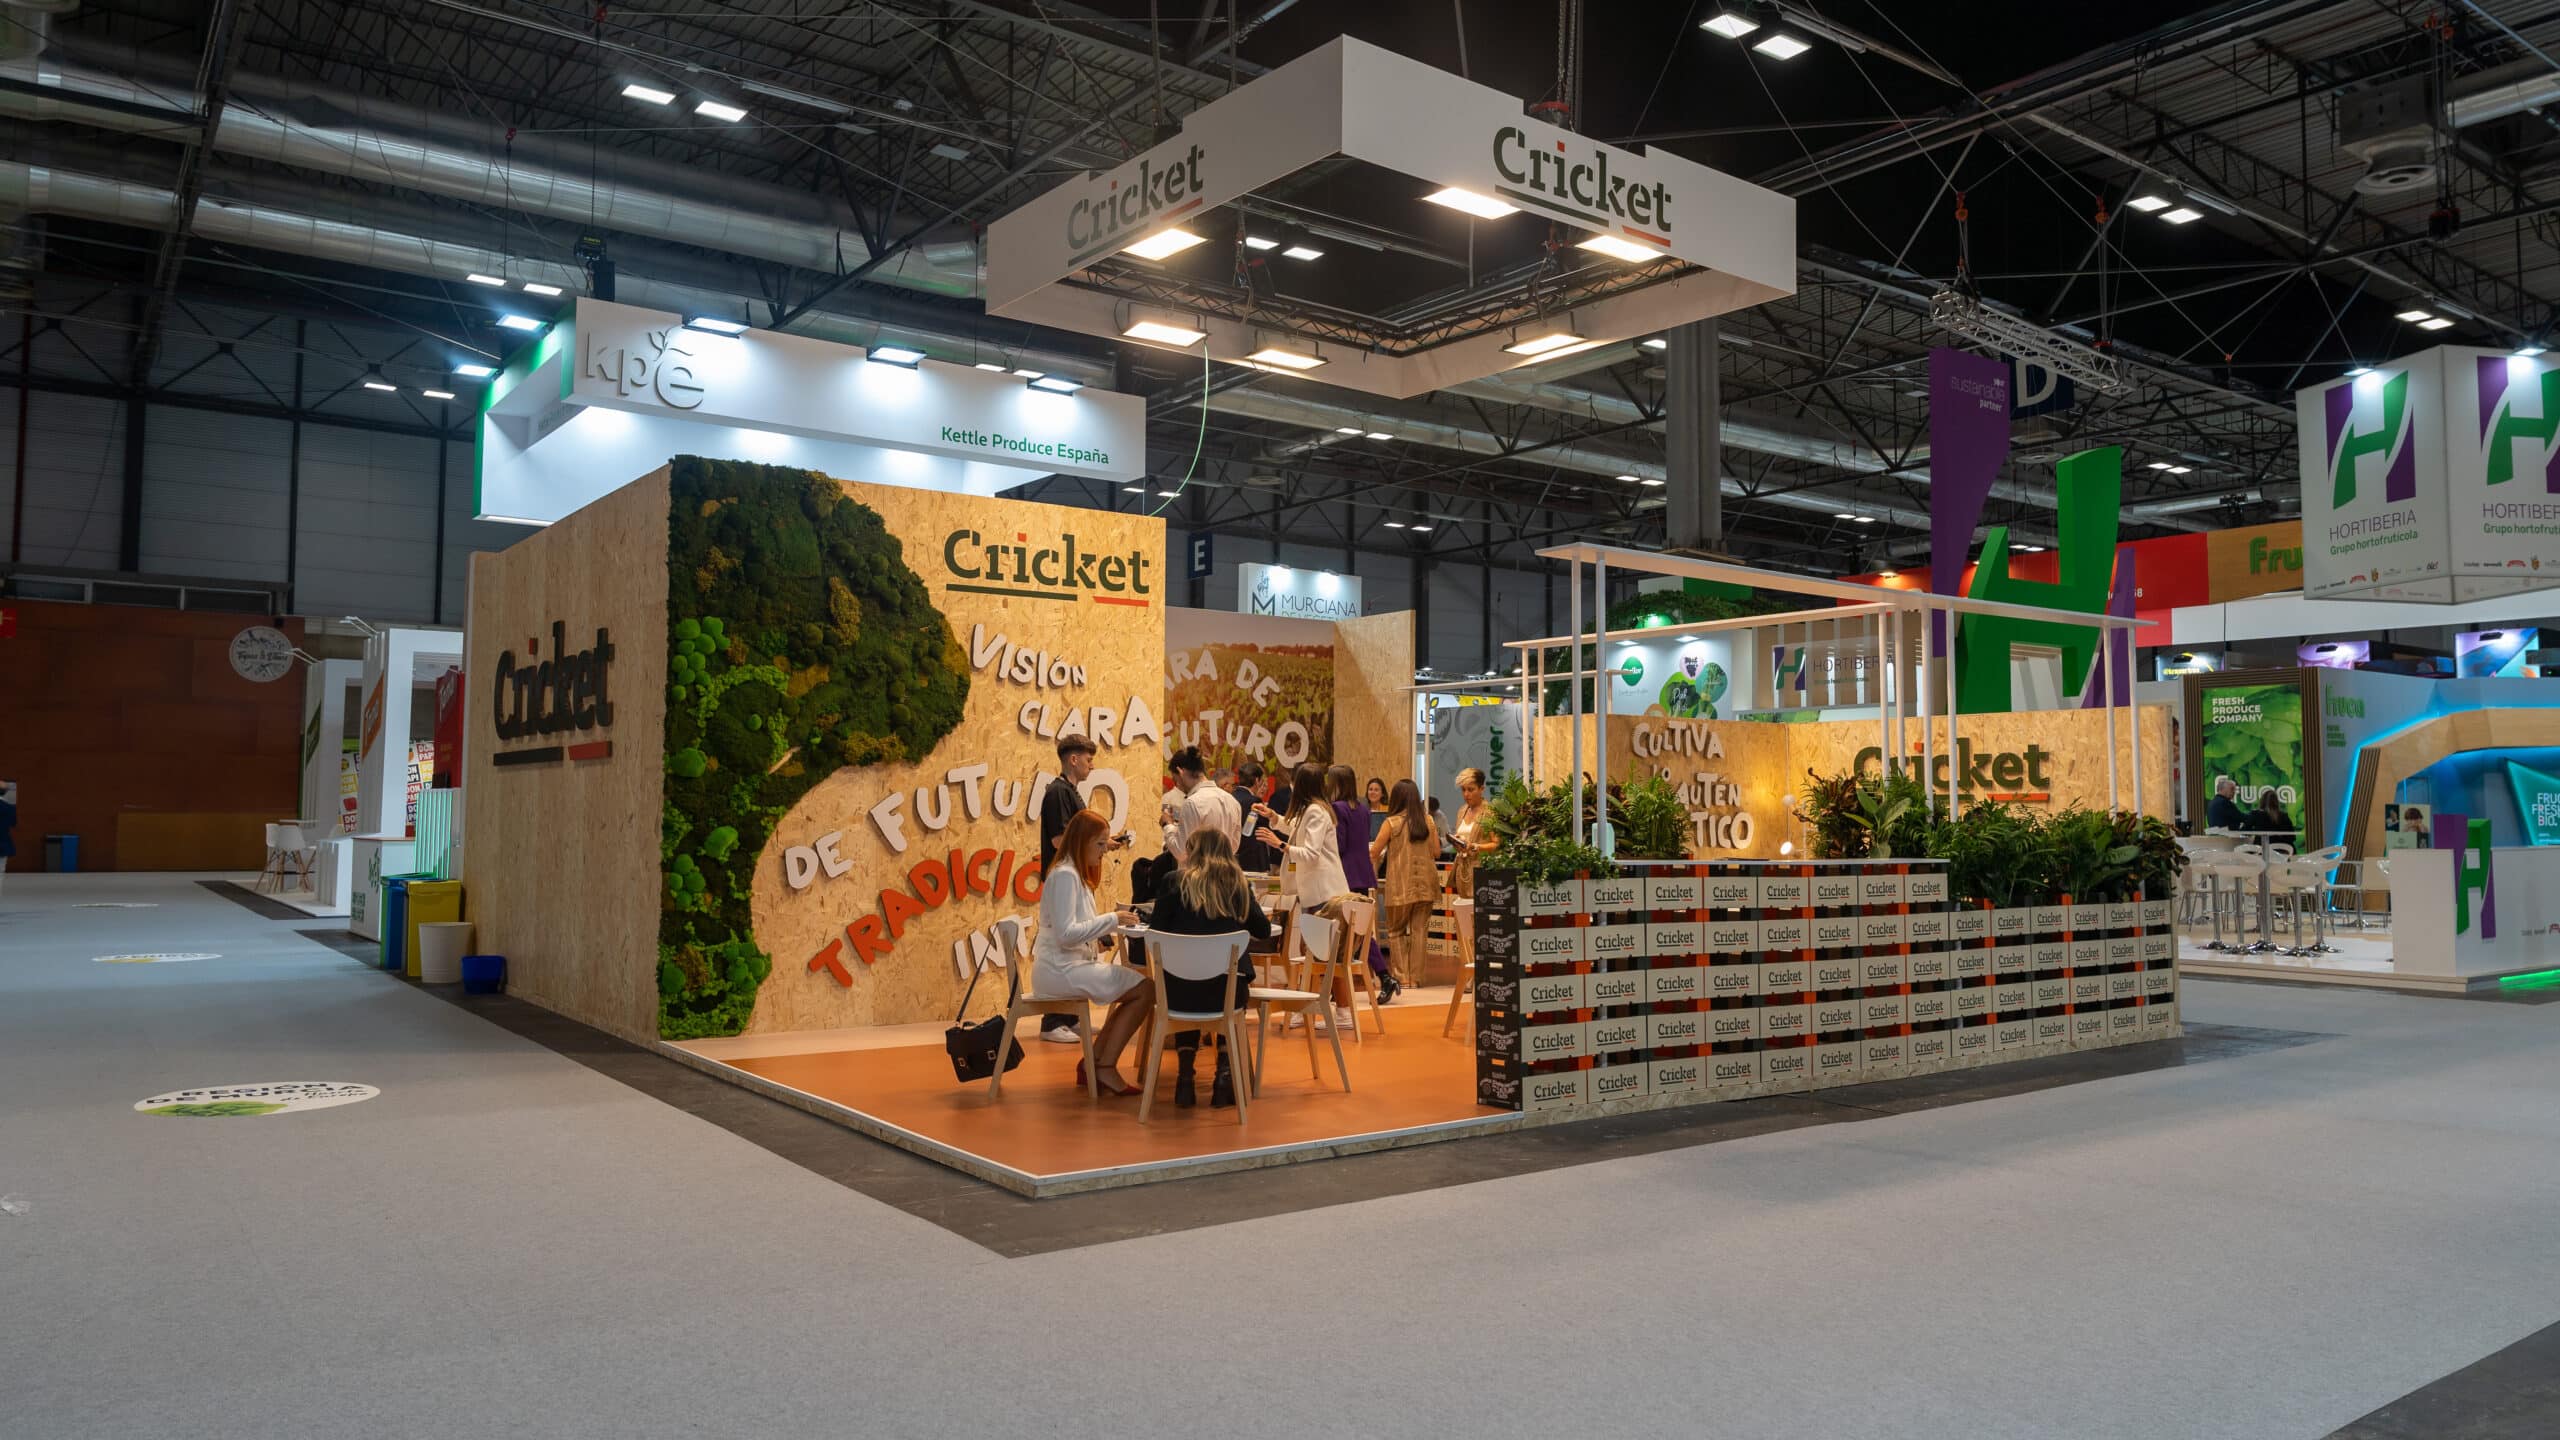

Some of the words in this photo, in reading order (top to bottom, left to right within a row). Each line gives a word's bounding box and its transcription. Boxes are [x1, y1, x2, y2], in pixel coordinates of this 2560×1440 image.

[1493, 127, 1671, 232] Cricket
[1067, 144, 1204, 250] Cricket
[2016, 357, 2058, 408] D
[942, 426, 987, 446] Kettle
[993, 434, 1053, 456] Produce
[1058, 444, 1109, 464] España
[2329, 509, 2417, 541] HORTIBERIA
[2484, 523, 2513, 536] Grupo
[1194, 540, 1206, 572] E
[2330, 543, 2356, 555] Grupo
[944, 530, 1150, 594] Cricket
[1281, 594, 1357, 617] MURCIANA
[971, 624, 1086, 688] VISIÓN
[494, 620, 615, 740] Cricket
[1236, 658, 1280, 707] DE
[2212, 697, 2244, 706] FRESH
[2212, 705, 2261, 715] PRODUCE
[1020, 696, 1158, 747] CLARA
[2212, 714, 2263, 724] COMPANY
[1633, 720, 1725, 759] CULTIVA
[1674, 772, 1741, 811] AUTÉN
[1690, 811, 1755, 849] TICO
[784, 831, 854, 890] DE
[1594, 886, 1634, 902] Cricket
[1655, 884, 1694, 898] Cricket
[1712, 885, 1748, 898] Cricket
[1766, 884, 1800, 897] Cricket
[1817, 883, 1850, 897] Cricket
[1866, 881, 1897, 895] Cricket
[1912, 881, 1941, 895] Cricket
[1530, 888, 1572, 904] Cricket
[809, 848, 1042, 987] TRADICIÓ
[1956, 916, 1984, 930] Cricket
[1998, 915, 2024, 929] Cricket
[2037, 912, 2062, 925] Cricket
[2075, 911, 2099, 925] Cricket
[1767, 926, 1801, 940] Cricket
[1818, 925, 1851, 939] Cricket
[1866, 922, 1897, 935] Cricket
[1912, 920, 1941, 934] Cricket
[1595, 933, 1635, 949] Cricket
[1656, 929, 1694, 944] Cricket
[1713, 929, 1749, 944] Cricket
[954, 914, 1040, 979] INT
[1531, 936, 1573, 952] Cricket
[1998, 952, 2025, 965] Cricket
[2037, 948, 2063, 962] Cricket
[2075, 947, 2100, 960] Cricket
[1913, 960, 1943, 974] Cricket
[1957, 955, 1985, 969] Cricket
[1768, 969, 1802, 983] Cricket
[1819, 967, 1851, 981] Cricket
[1867, 963, 1898, 977] Cricket
[1656, 975, 1694, 990] Cricket
[1713, 973, 1749, 988] Cricket
[1531, 984, 1574, 1000] Cricket
[1595, 980, 1636, 996] Cricket
[2038, 985, 2064, 999] Cricket
[2076, 983, 2100, 997] Cricket
[1958, 993, 1985, 1007] Cricket
[1998, 991, 2025, 1004] Cricket
[1868, 1003, 1899, 1017] Cricket
[1914, 1000, 1944, 1014] Cricket
[1769, 1012, 1803, 1026] Cricket
[1820, 1009, 1852, 1023] Cricket
[1657, 1020, 1696, 1036] Cricket
[1714, 1017, 1750, 1032] Cricket
[2039, 1022, 2065, 1035] Cricket
[2078, 1019, 2101, 1032] Cricket
[1533, 1032, 1575, 1049] Cricket
[1596, 1026, 1636, 1043] Cricket
[1960, 1033, 1986, 1046] Cricket
[2000, 1028, 2027, 1041] Cricket
[1869, 1044, 1900, 1058] Cricket
[1914, 1039, 1944, 1054] Cricket
[1770, 1055, 1804, 1070] Cricket
[1821, 1050, 1853, 1065] Cricket
[1659, 1065, 1697, 1081] Cricket
[1715, 1061, 1752, 1077] Cricket
[1534, 1080, 1576, 1097] Cricket
[1598, 1073, 1638, 1090] Cricket
